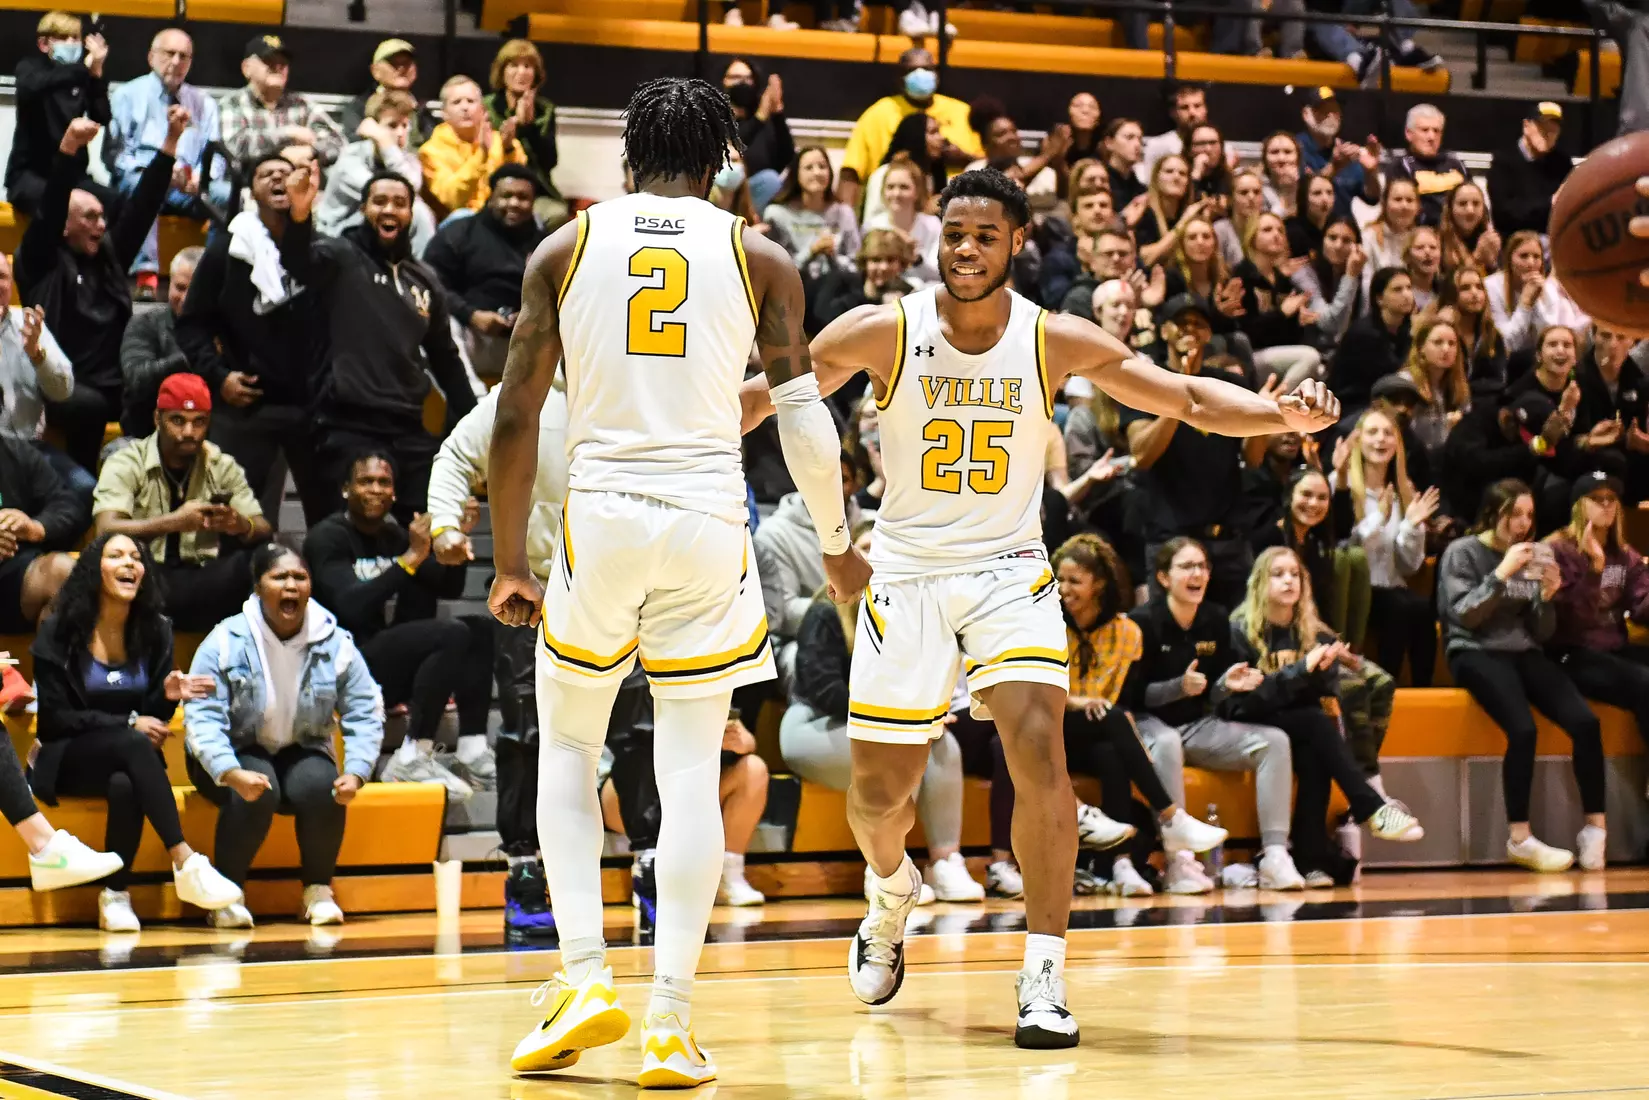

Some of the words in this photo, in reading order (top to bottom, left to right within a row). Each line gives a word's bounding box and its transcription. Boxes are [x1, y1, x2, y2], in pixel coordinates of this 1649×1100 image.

[634, 216, 686, 229] PSAC
[626, 246, 689, 358] 2
[918, 375, 1023, 414] VILLE
[921, 418, 1014, 494] 25
